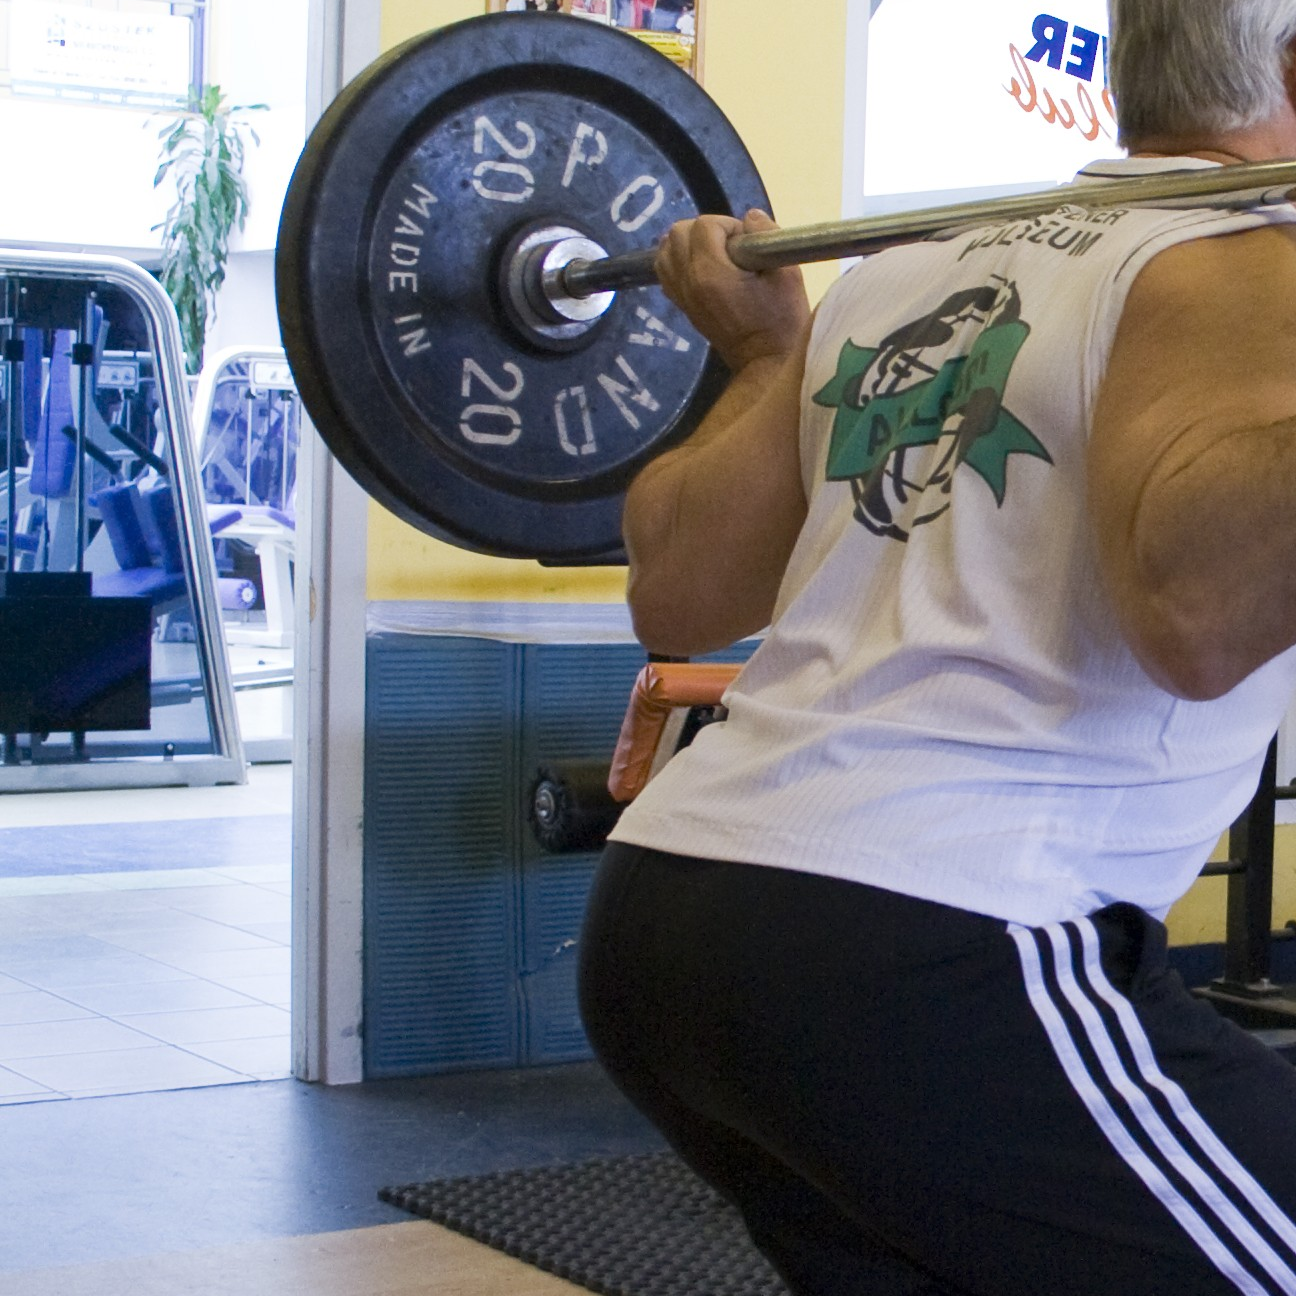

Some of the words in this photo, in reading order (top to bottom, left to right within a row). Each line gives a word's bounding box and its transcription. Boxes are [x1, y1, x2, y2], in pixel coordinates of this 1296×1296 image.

[473, 116, 536, 203] 20
[388, 183, 438, 292] MADE
[554, 121, 691, 456] POAND
[395, 313, 432, 356] IN
[459, 358, 524, 445] 20
